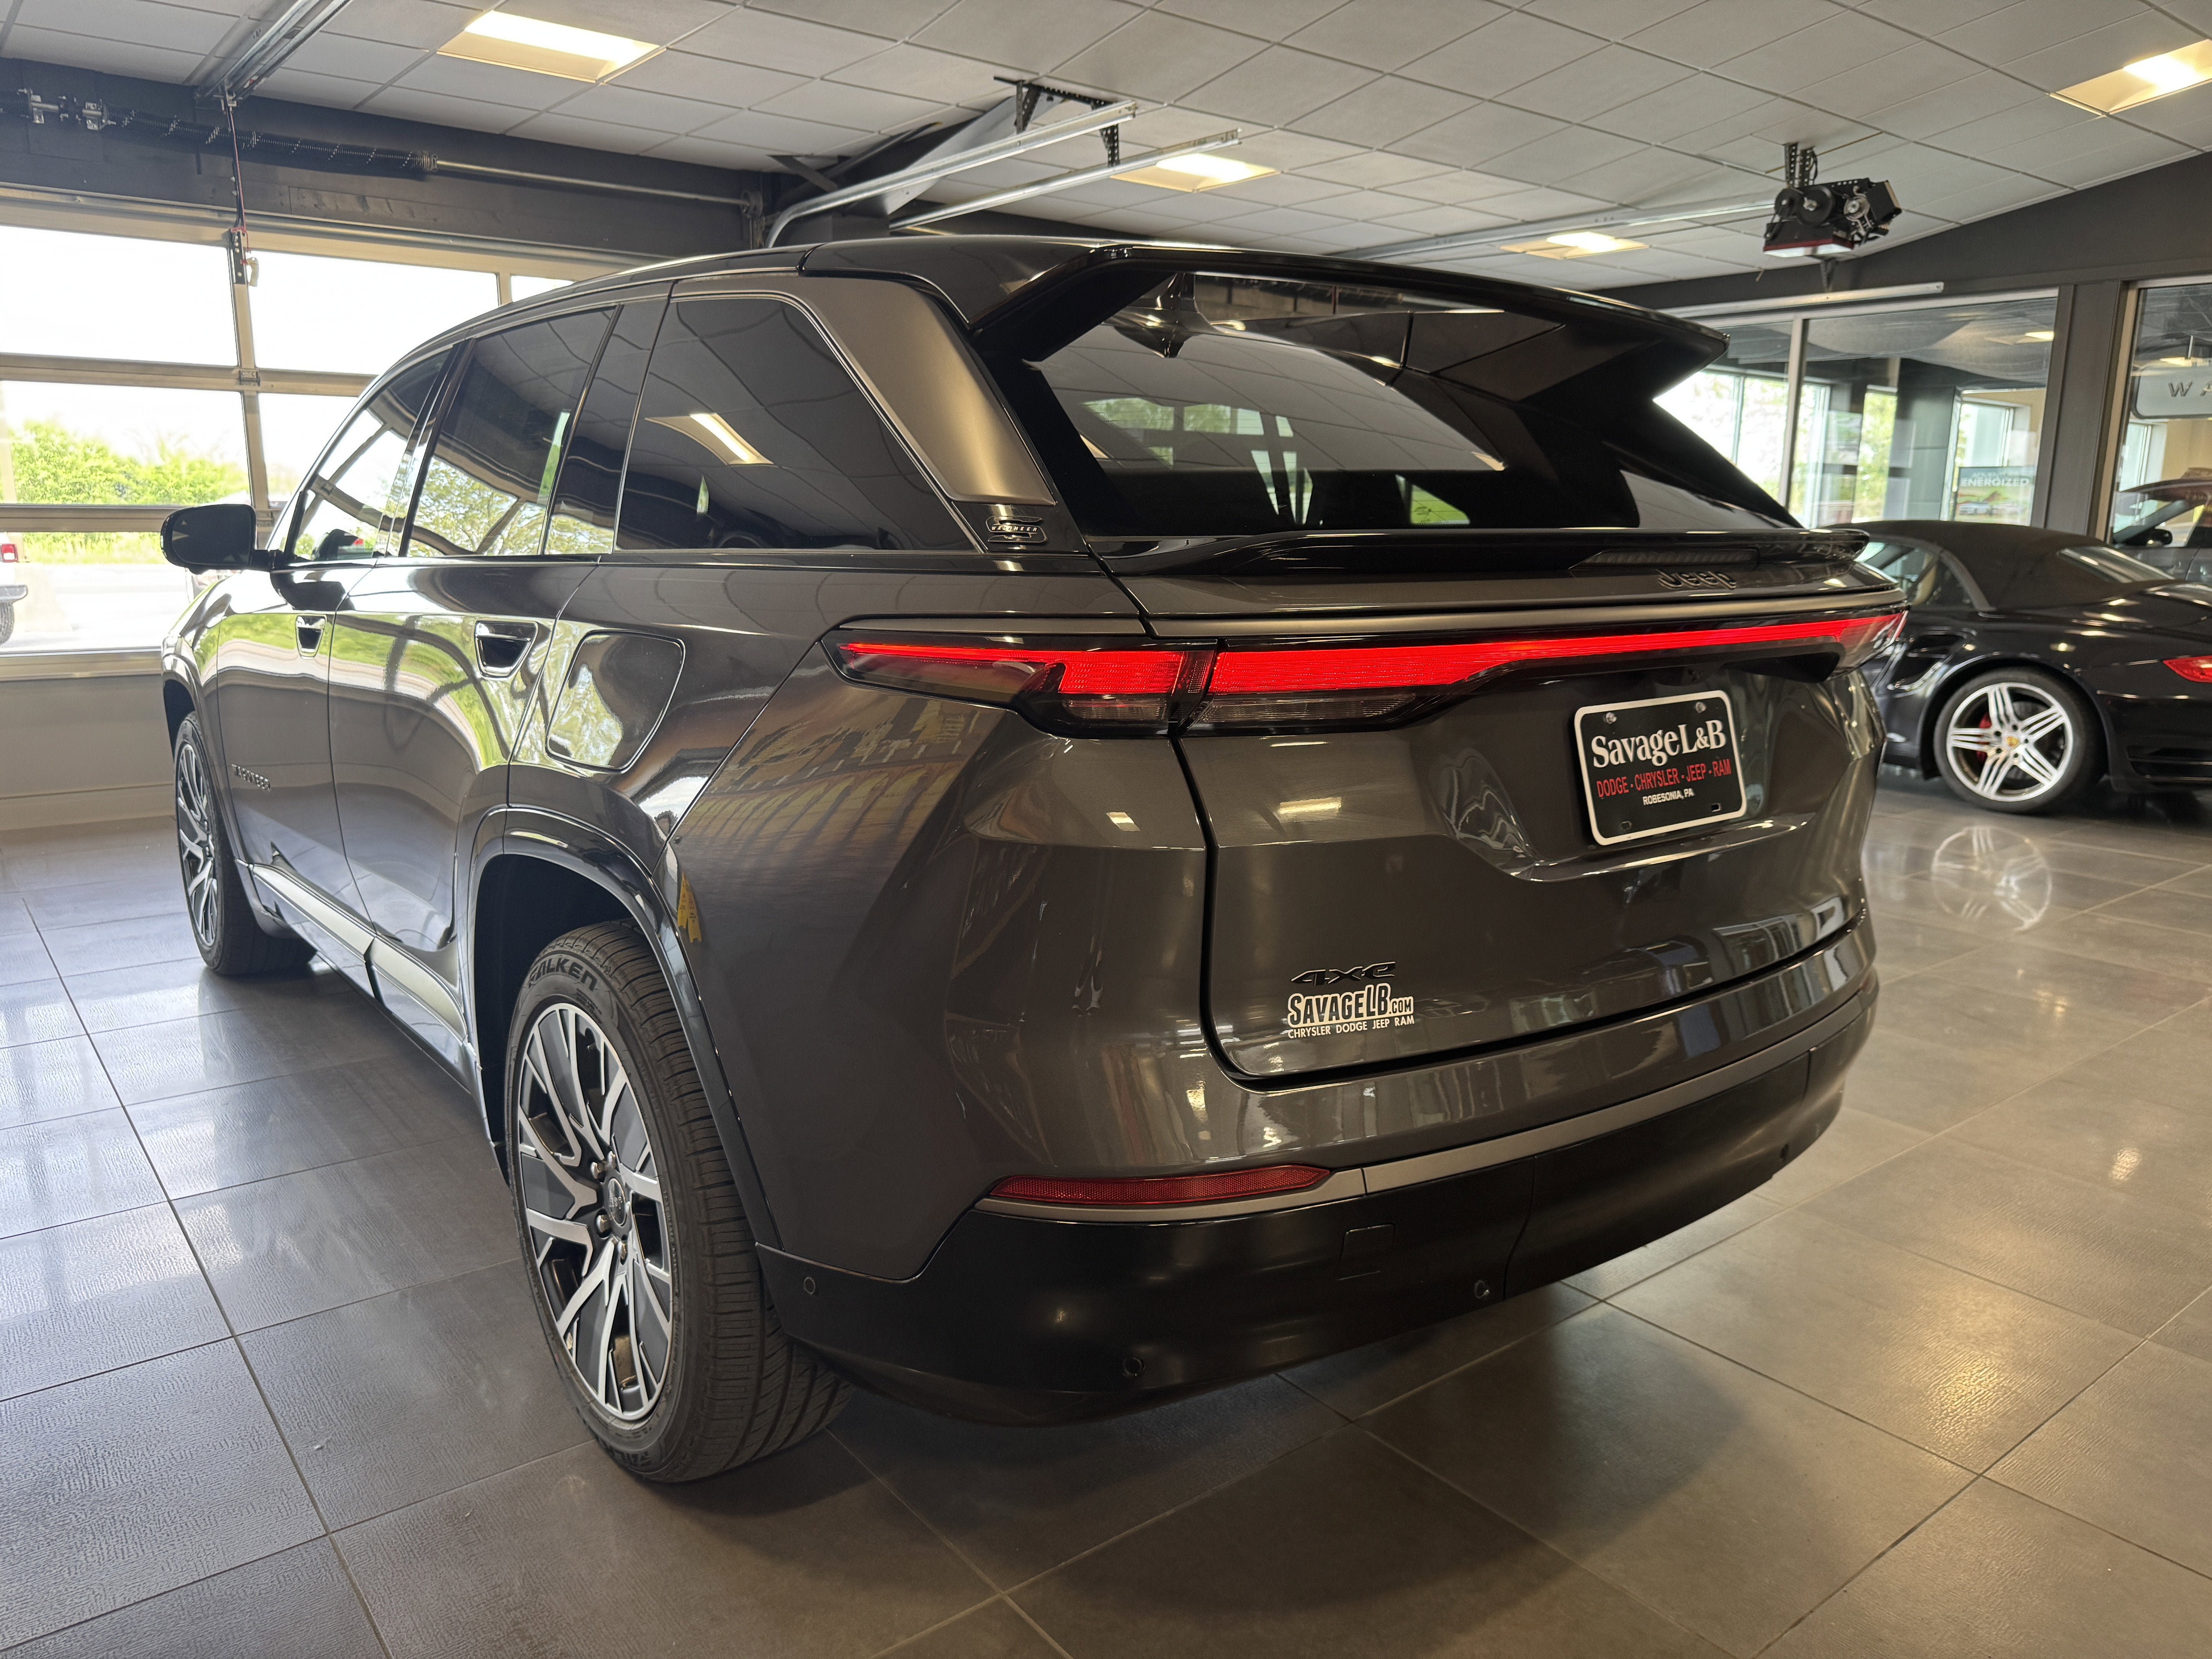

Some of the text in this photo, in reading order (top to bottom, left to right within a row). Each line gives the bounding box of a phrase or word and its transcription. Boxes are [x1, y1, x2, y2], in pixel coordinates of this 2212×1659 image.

[1597, 759, 1731, 798] DODGE CHRYSLER JEEP RAM
[1643, 788, 1694, 805] ROBESONIA, PA
[527, 957, 598, 991] FALKEN
[1288, 1015, 1414, 1039] CHRYSLER DODGE JEEP RAM
